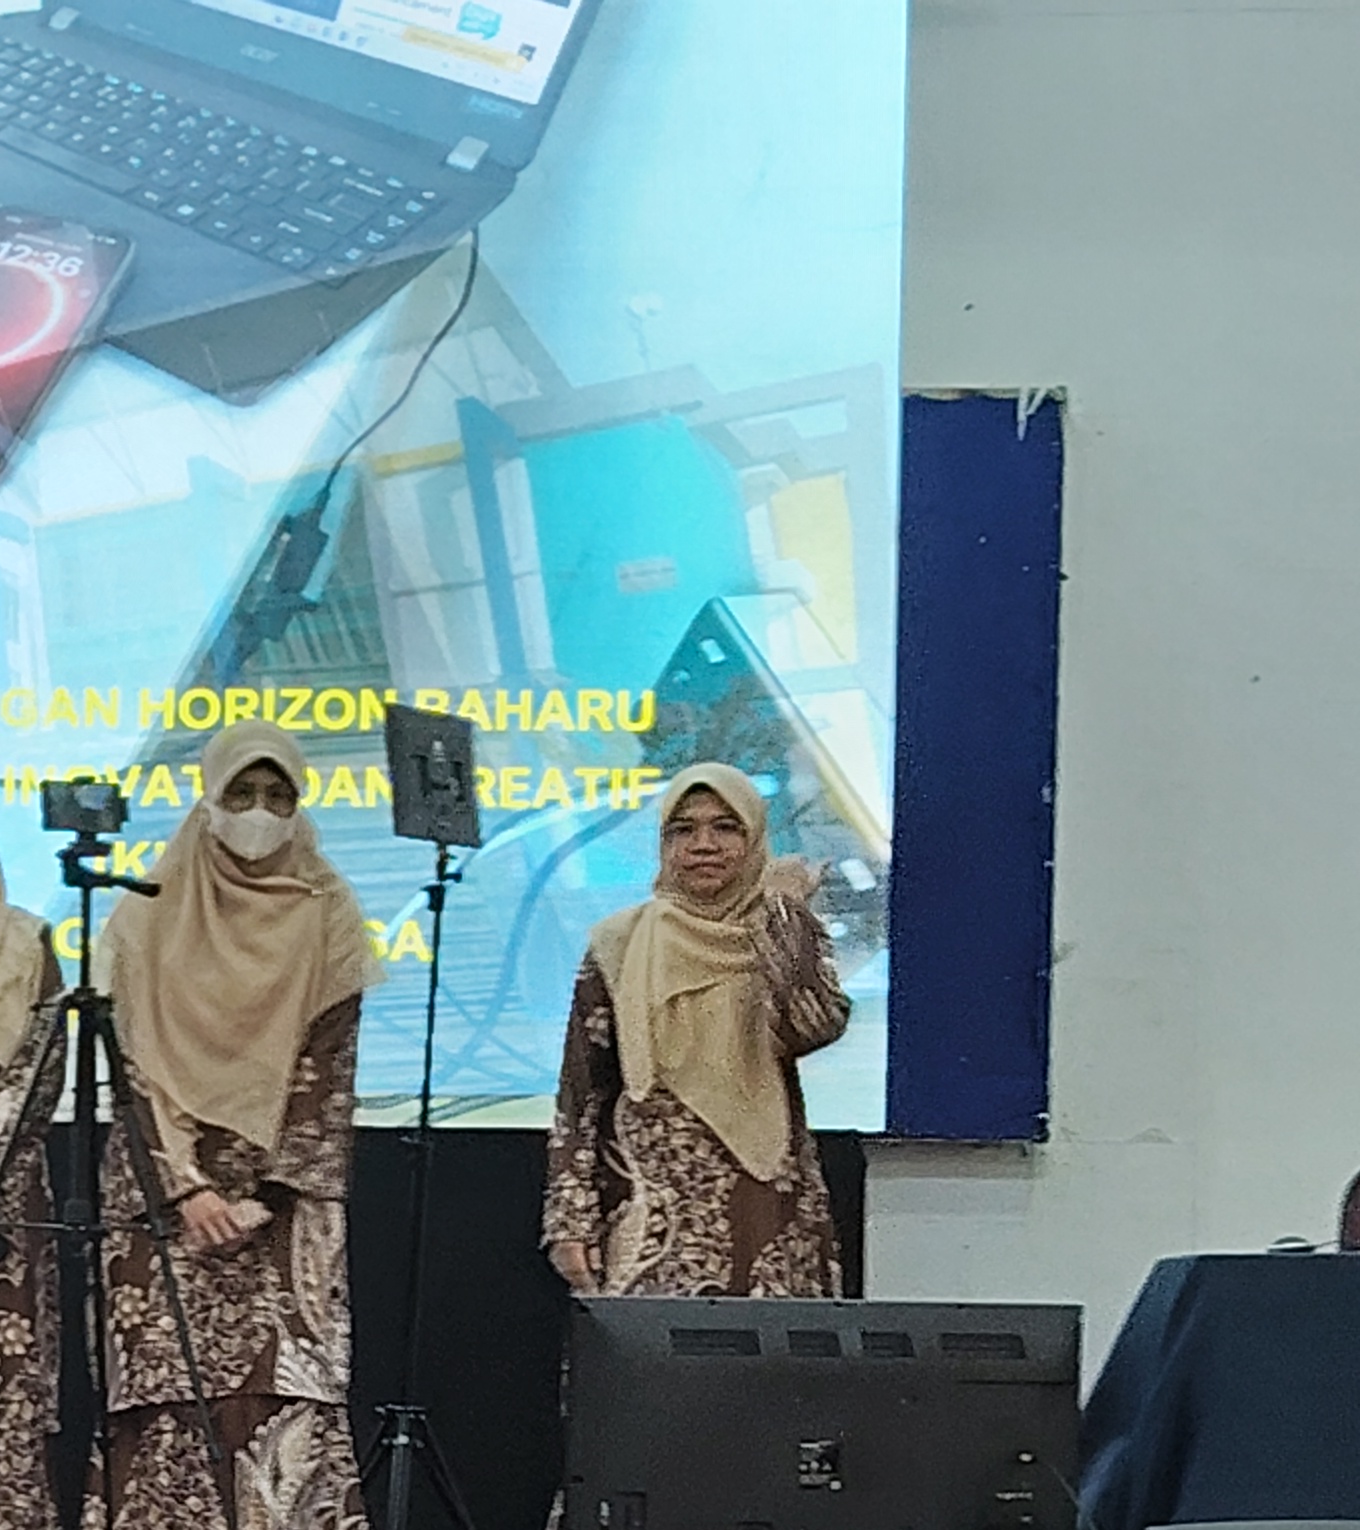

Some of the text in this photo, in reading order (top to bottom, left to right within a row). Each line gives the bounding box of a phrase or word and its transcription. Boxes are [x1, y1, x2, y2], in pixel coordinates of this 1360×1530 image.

[139, 687, 397, 731] HORIZON
[415, 688, 656, 732] BAHARU
[3, 764, 205, 807] INVAT
[474, 767, 662, 810] REATIF
